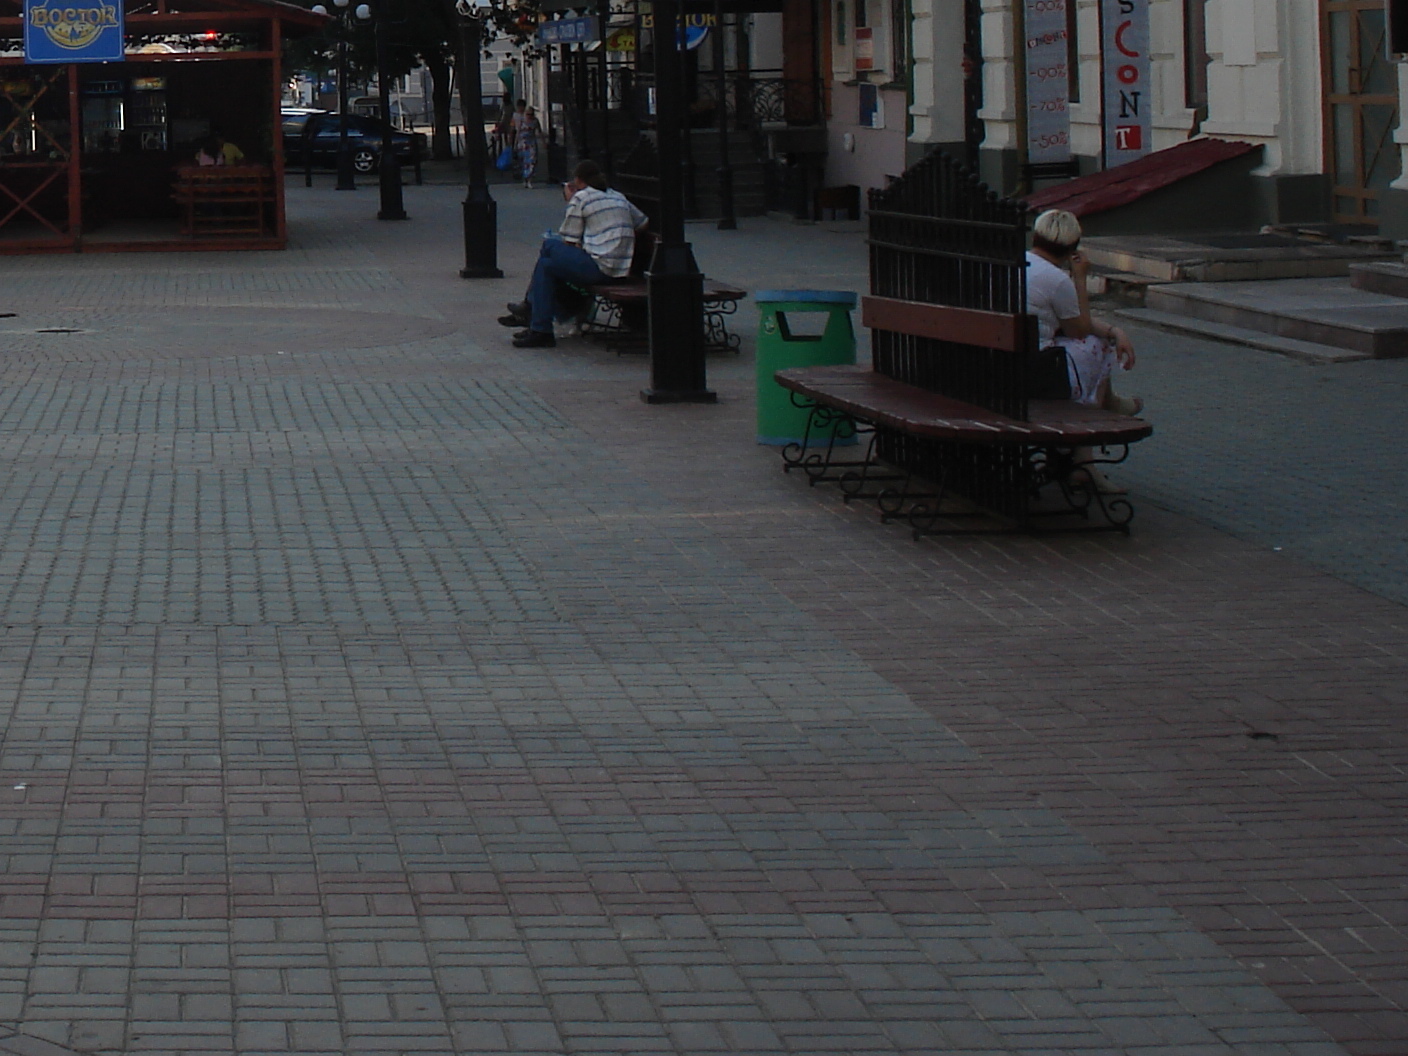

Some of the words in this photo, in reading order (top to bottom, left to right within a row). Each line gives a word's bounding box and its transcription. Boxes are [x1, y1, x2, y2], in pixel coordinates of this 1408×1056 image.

[32, 7, 118, 26] ВОСТОК
[1029, 64, 1066, 81] -90%
[1030, 97, 1066, 111] -70%
[1031, 131, 1068, 148] -50%
